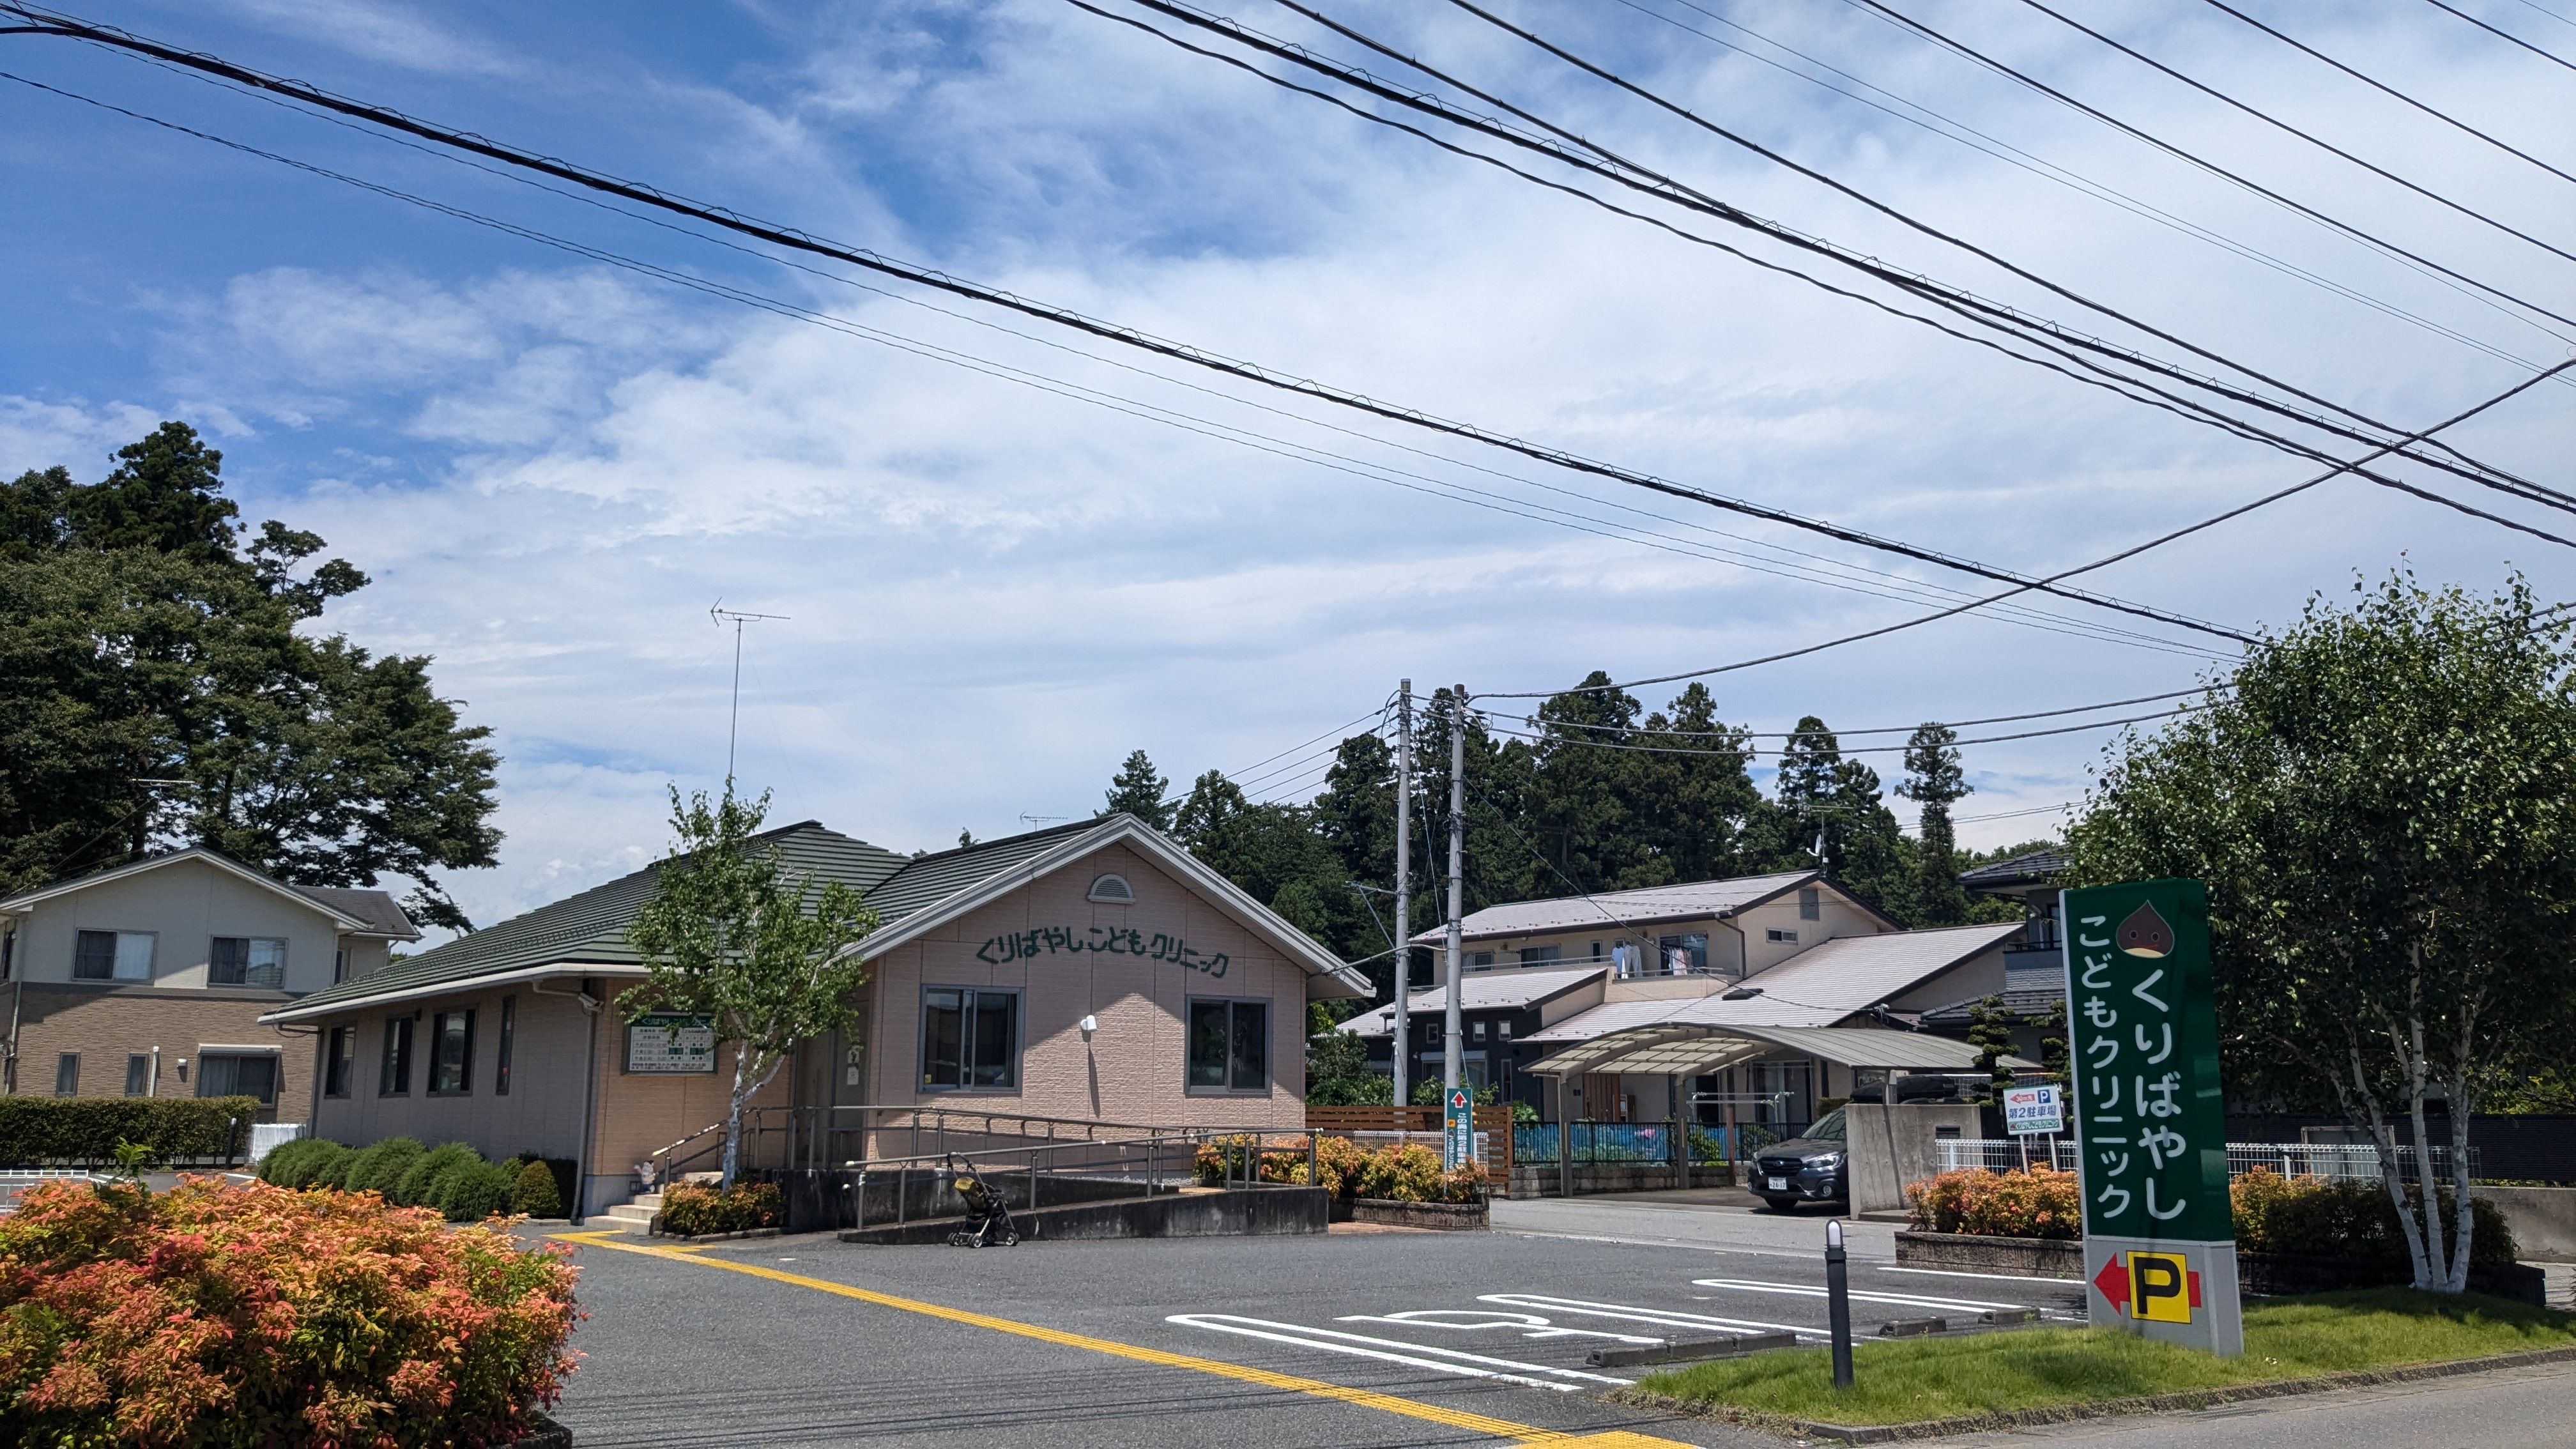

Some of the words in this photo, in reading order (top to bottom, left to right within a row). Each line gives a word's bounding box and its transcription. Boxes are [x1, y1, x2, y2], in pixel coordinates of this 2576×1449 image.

[2040, 1091, 2048, 1103] P
[2079, 916, 2130, 1219] こどもクリニック
[2132, 969, 2186, 1221] くりばやし
[2008, 1105, 2057, 1119] 第2駐車場
[2133, 1256, 2181, 1315] P
